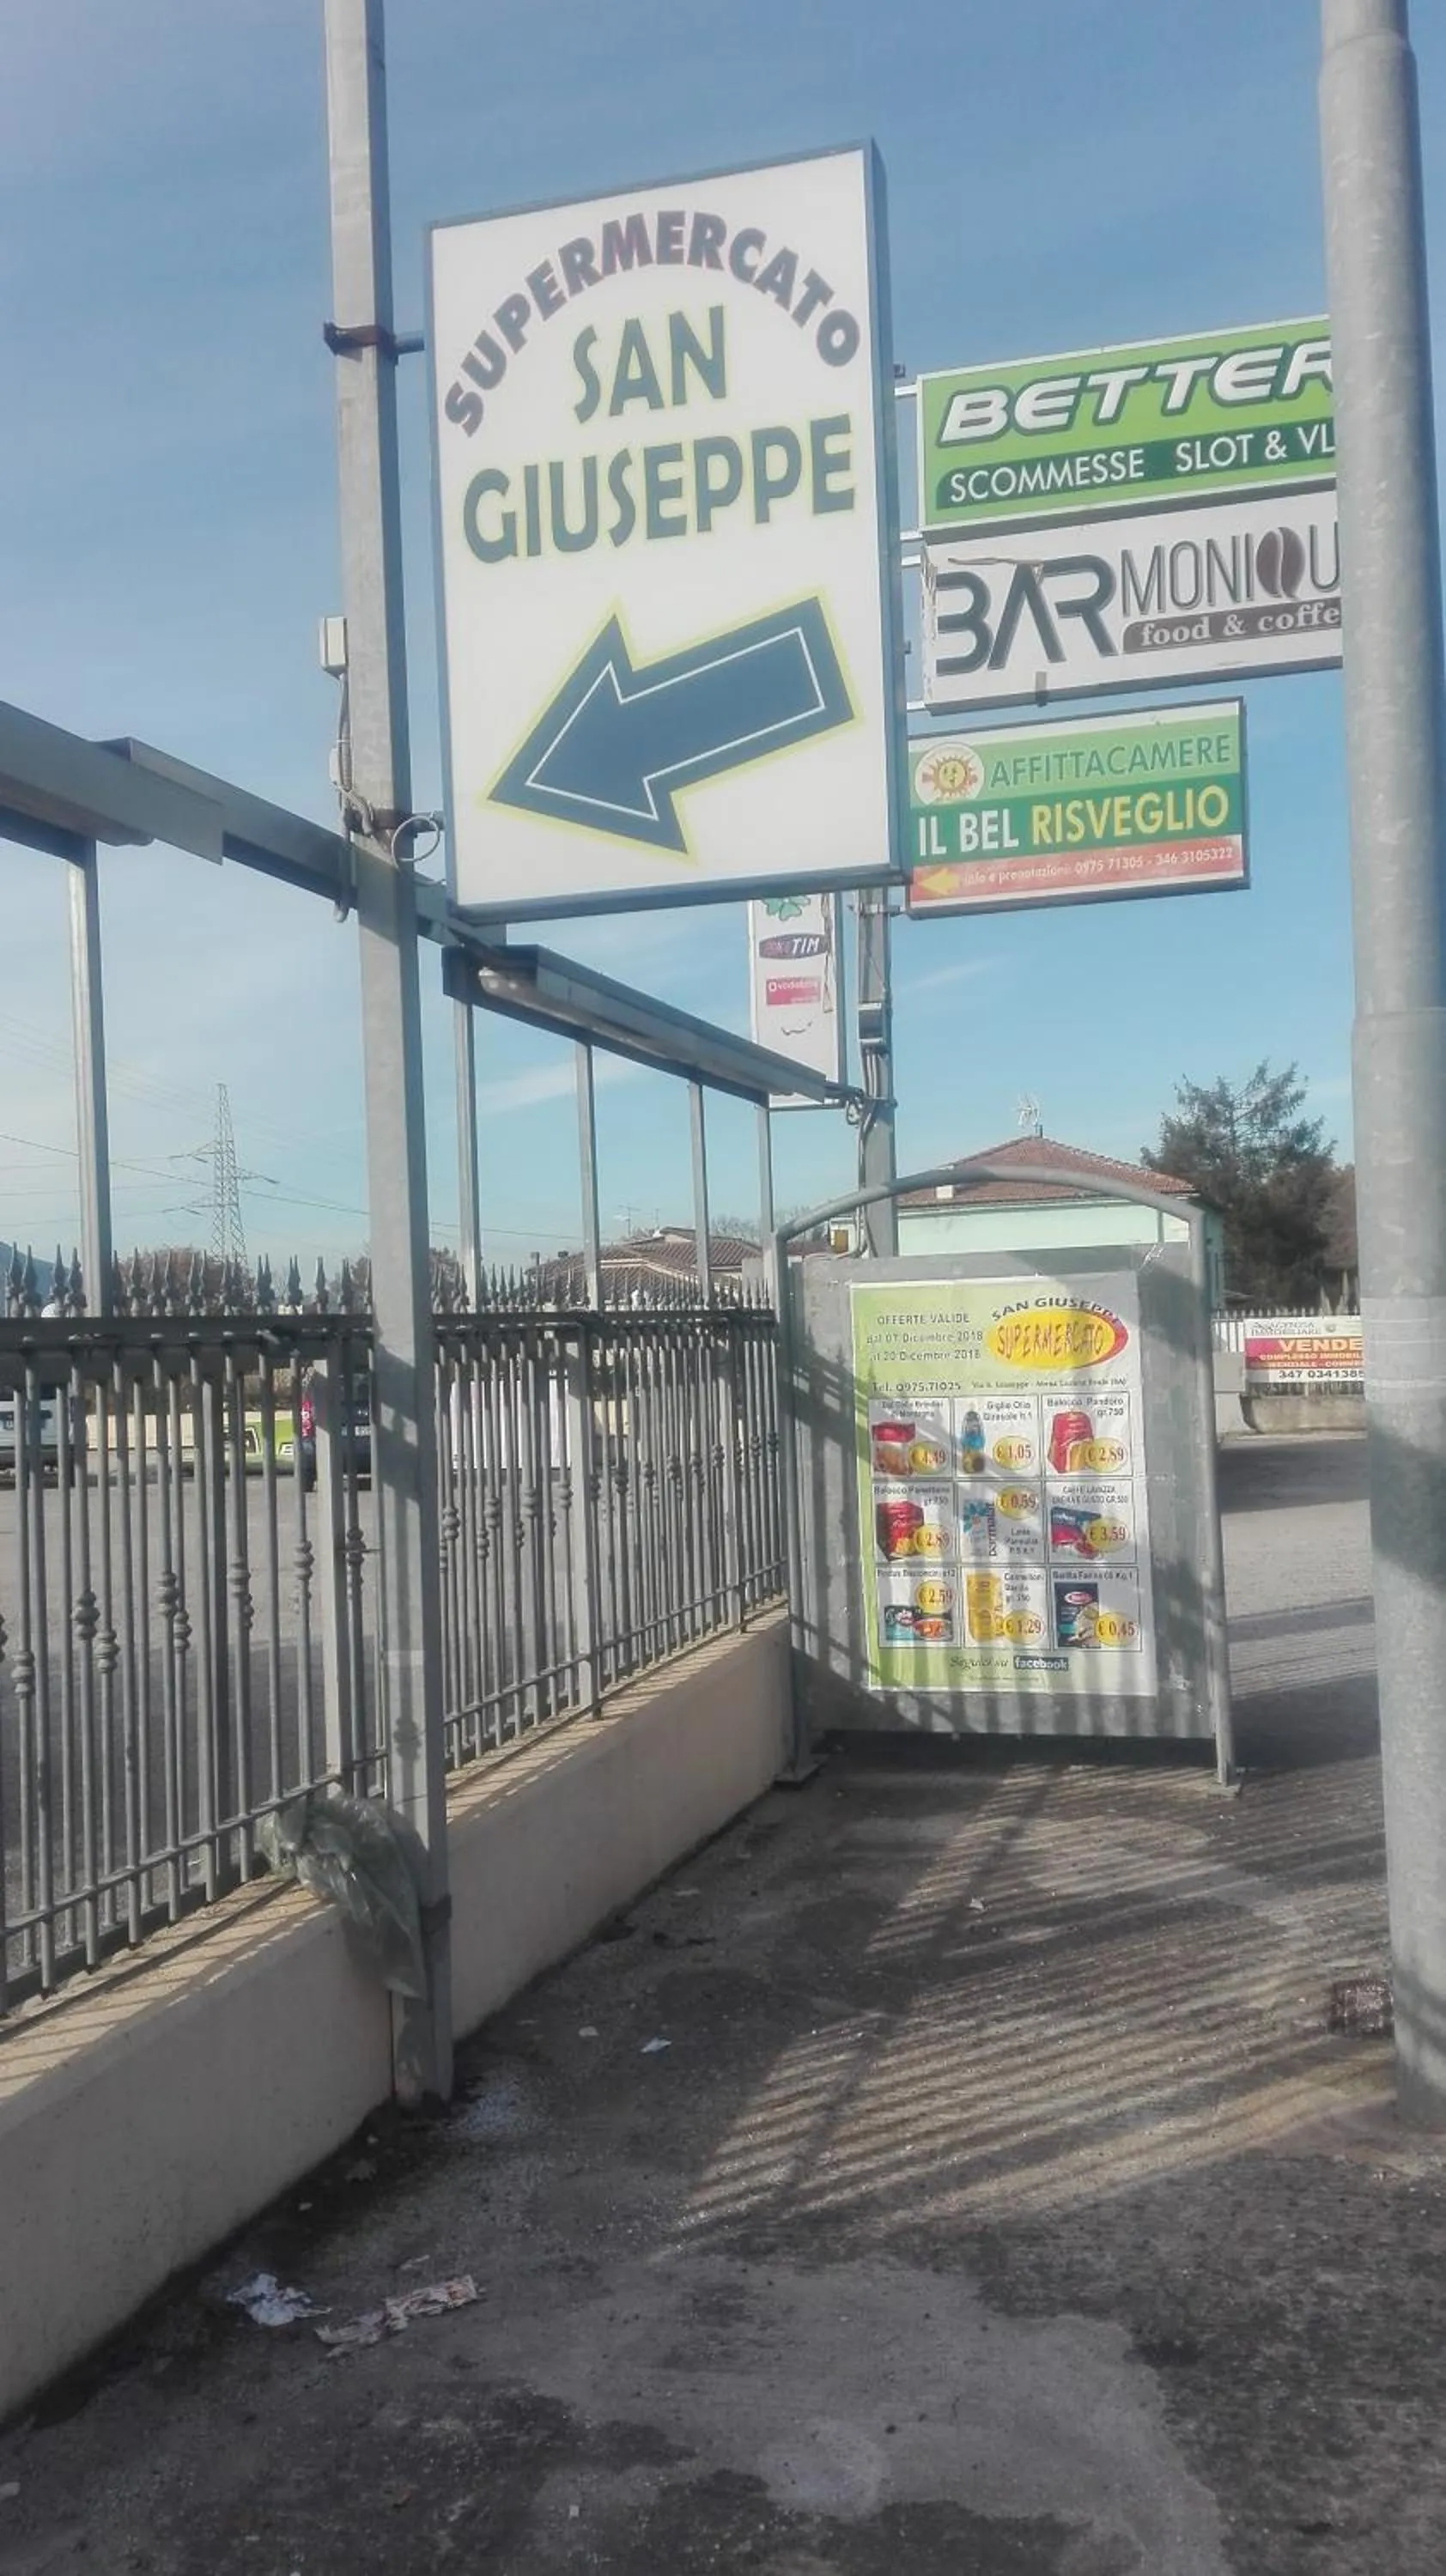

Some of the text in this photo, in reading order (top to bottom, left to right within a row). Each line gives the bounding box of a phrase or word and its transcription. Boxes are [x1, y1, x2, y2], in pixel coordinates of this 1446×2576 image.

[444, 210, 860, 437] SUPERMERCATO
[572, 304, 726, 424] SAN
[939, 338, 1333, 445] BETTER
[950, 424, 1334, 503] SCOMMESSE SLOT & VL
[463, 413, 855, 564] GIUSEPPE
[1121, 519, 1340, 618] MONIQU
[935, 554, 1119, 677] BAR
[1140, 599, 1340, 647] food & coffe
[990, 734, 1230, 788] AFFITTACAMERE
[919, 786, 1230, 857] IL BEL RISVEGLIO
[1075, 860, 1103, 875] 0975
[791, 937, 820, 954] TIM
[877, 1312, 971, 1325] OFFERTE VALIDE
[992, 1301, 1029, 1321] SAN
[899, 1349, 952, 1360] Dicembre
[902, 1331, 955, 1343] Dicembre
[957, 1329, 983, 1341] 2018
[997, 1321, 1104, 1359] SUPERMERCATO
[1279, 1370, 1303, 1378] 347
[1086, 1396, 1124, 1406] Pandoro
[1015, 1656, 1068, 1670] facebook
